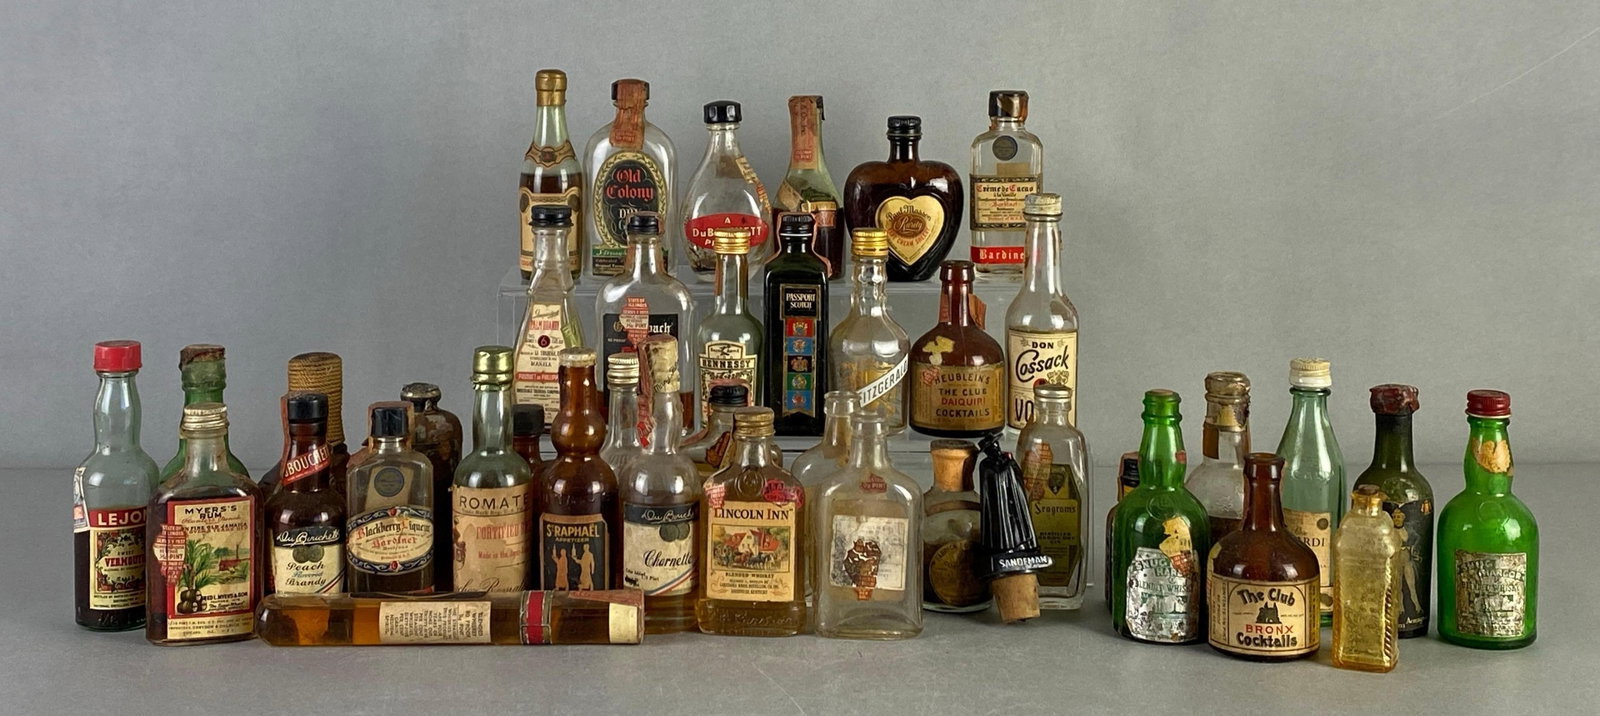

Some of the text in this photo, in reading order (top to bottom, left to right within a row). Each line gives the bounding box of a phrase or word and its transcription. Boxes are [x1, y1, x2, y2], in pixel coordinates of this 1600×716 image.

[616, 169, 641, 183] Old
[606, 184, 654, 201] Colony
[724, 216, 731, 224] A
[979, 249, 1025, 260] Bardine
[786, 292, 816, 302] PASSPORT
[540, 336, 548, 346] 6
[1032, 341, 1054, 350] DON
[702, 359, 751, 369] HENNESSY
[1015, 345, 1070, 383] Cossack
[860, 359, 908, 404] ITZGERALD
[934, 373, 990, 385] HEUBLEIN'S
[938, 388, 958, 396] THE
[942, 397, 986, 406] DAIQUIRI
[936, 408, 990, 418] COCKTAILS
[184, 504, 238, 515] MYERS'S
[714, 508, 790, 520] LINCOLN INN
[200, 512, 222, 520] RUM
[356, 522, 401, 541] Blackberry
[998, 554, 1049, 568] SANDEMAN
[286, 562, 324, 571] Peach
[286, 577, 326, 587] Brandy
[1236, 588, 1296, 606] The Club
[1245, 624, 1295, 634] BRONX
[1236, 632, 1298, 648] Cocktails
